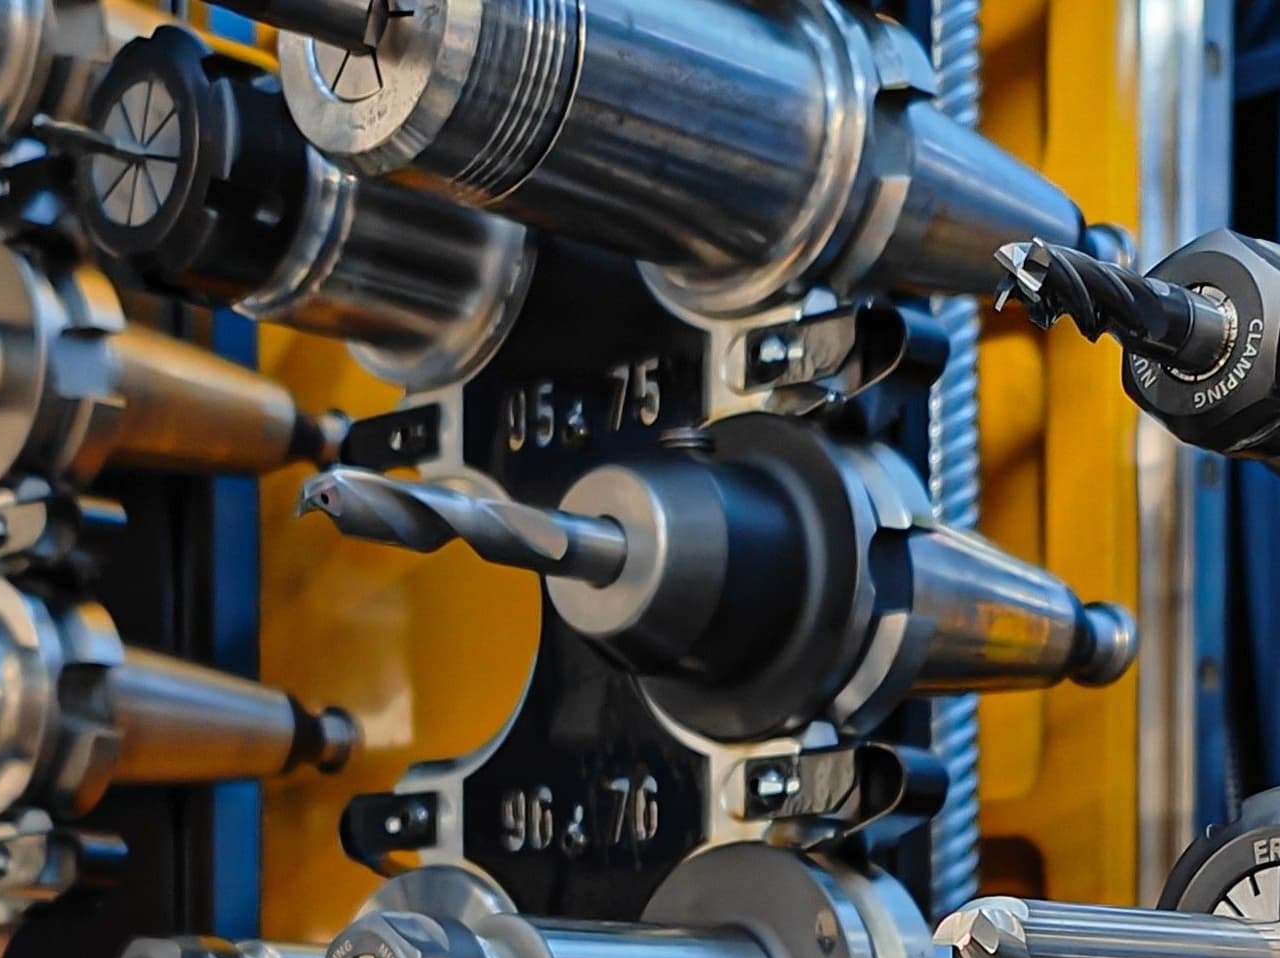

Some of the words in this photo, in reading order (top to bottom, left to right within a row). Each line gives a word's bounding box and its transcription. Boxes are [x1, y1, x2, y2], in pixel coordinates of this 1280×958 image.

[609, 358, 661, 431] 75
[1132, 354, 1157, 389] NU
[1193, 318, 1264, 409] CLAMPING
[504, 785, 554, 851] 96
[609, 775, 659, 840] 76
